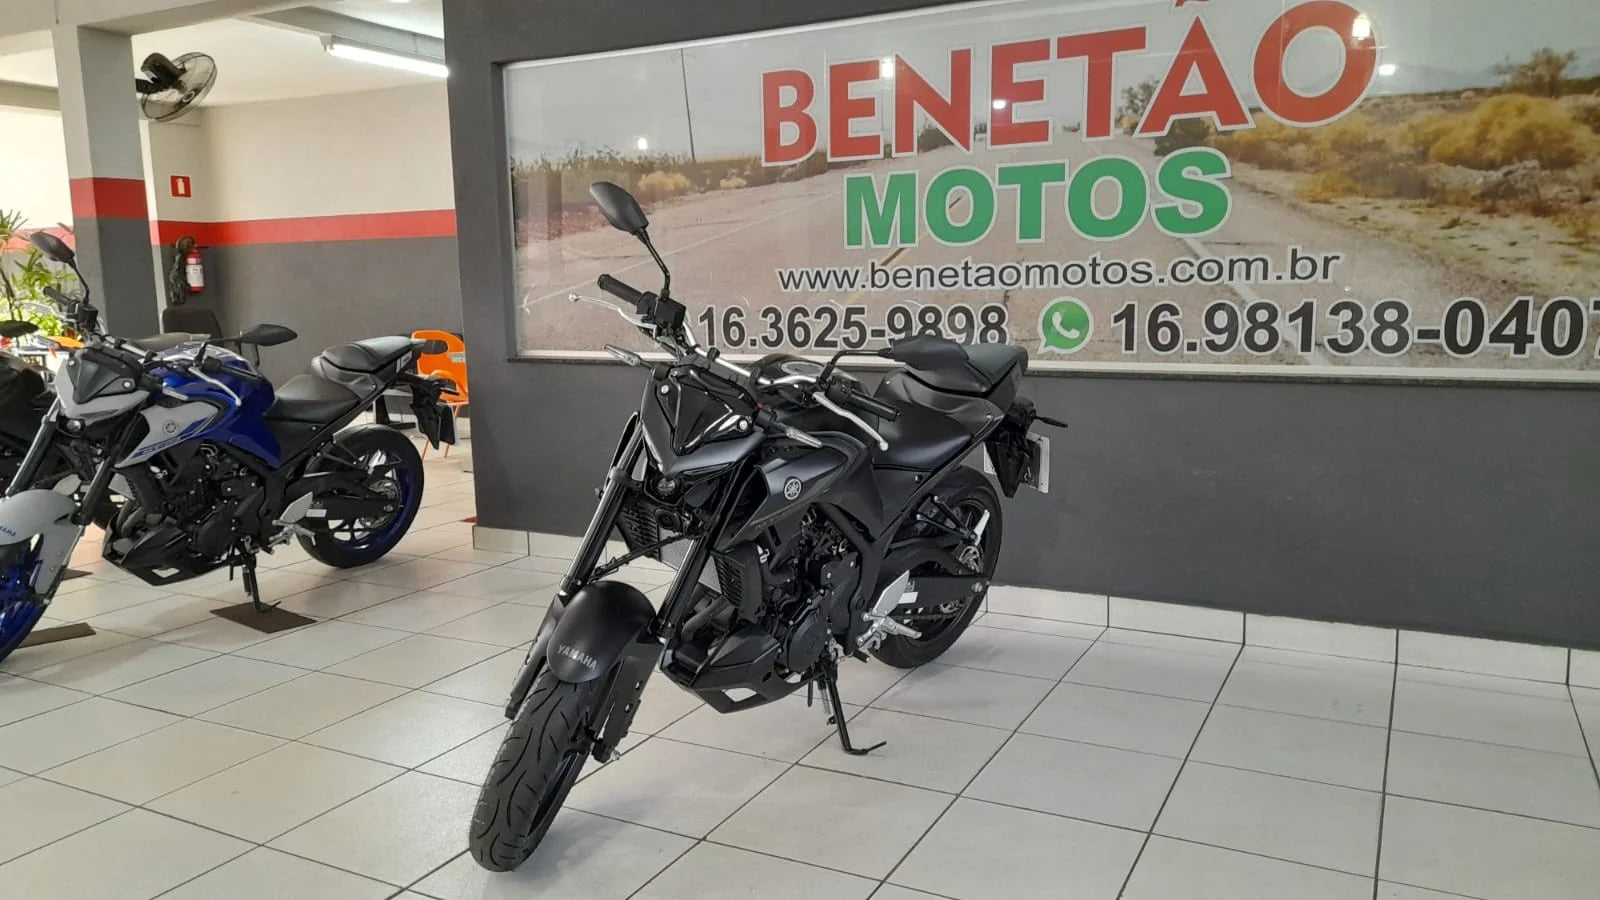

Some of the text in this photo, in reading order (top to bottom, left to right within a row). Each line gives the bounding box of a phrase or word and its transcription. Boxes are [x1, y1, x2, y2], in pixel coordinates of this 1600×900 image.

[761, 0, 1376, 166] BENETÃO
[845, 149, 1231, 247] MOTOS
[778, 247, 1342, 291] www.benetaomotos.com.br
[698, 304, 1008, 349] 16.3625-9898
[1112, 298, 1600, 357] 16.98138-040
[557, 644, 597, 671] YAMAHA
